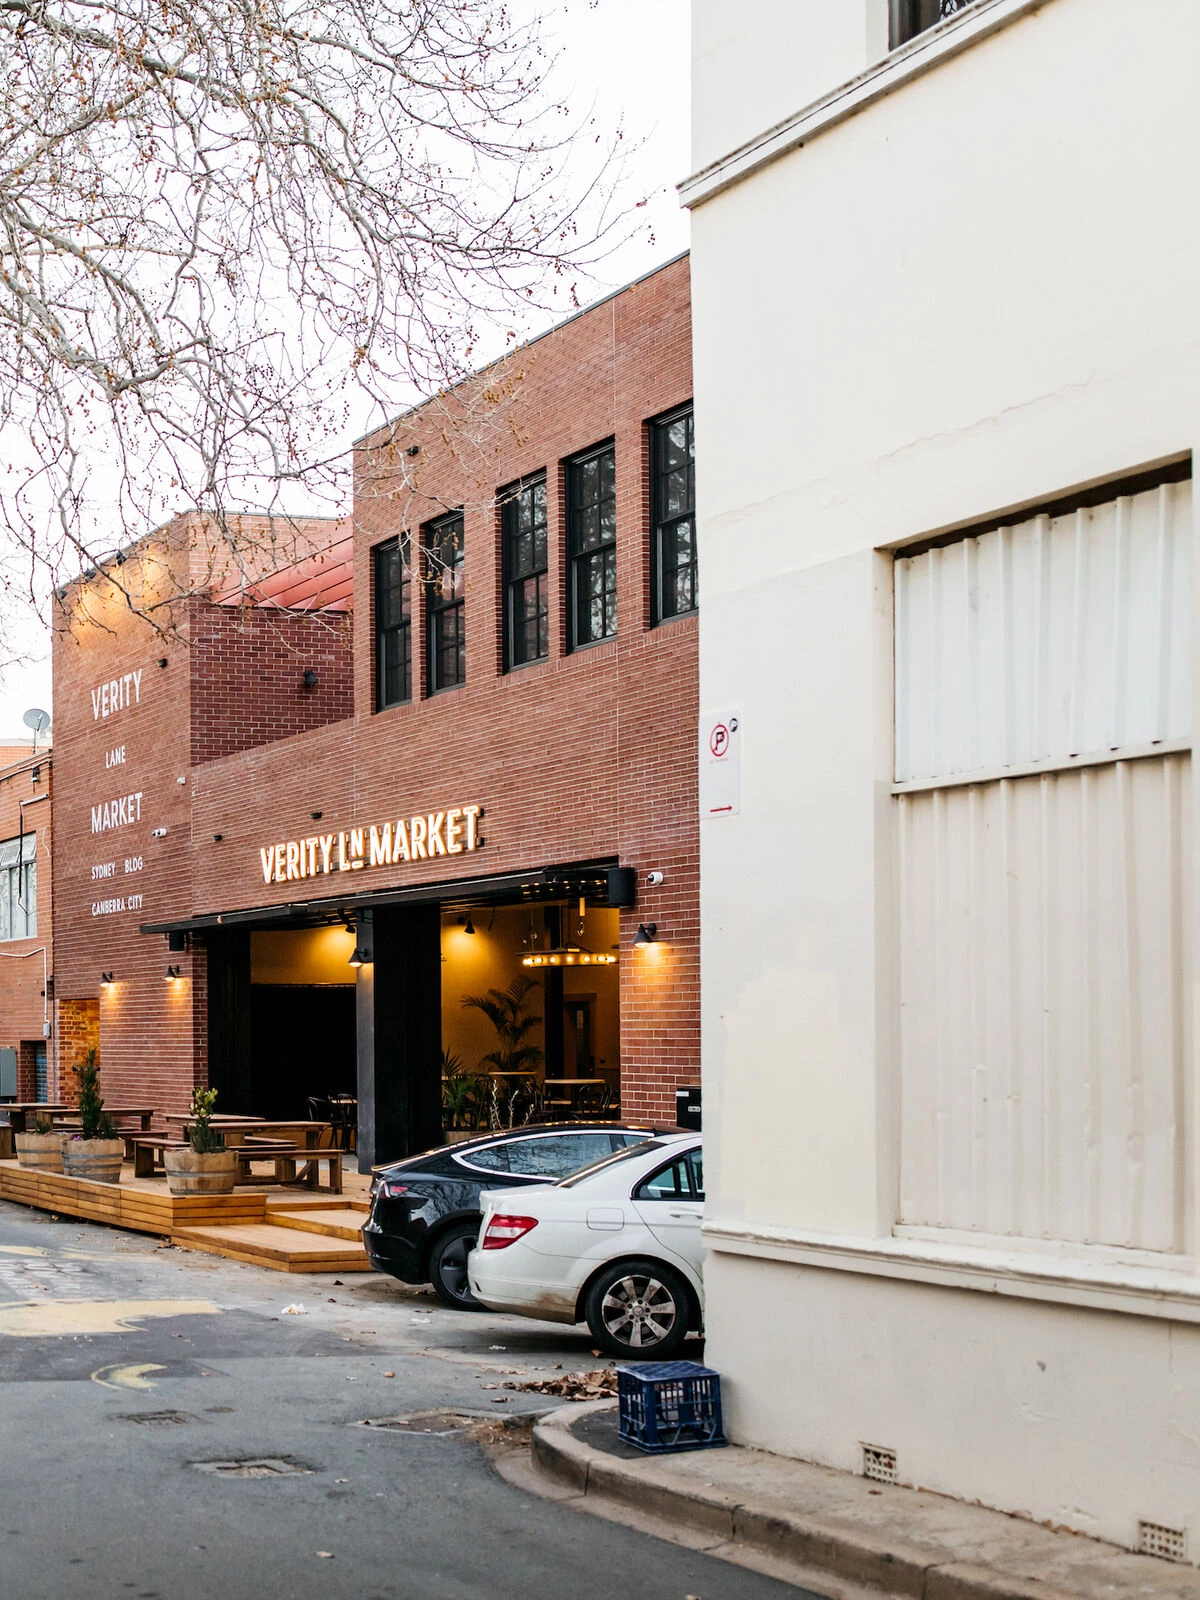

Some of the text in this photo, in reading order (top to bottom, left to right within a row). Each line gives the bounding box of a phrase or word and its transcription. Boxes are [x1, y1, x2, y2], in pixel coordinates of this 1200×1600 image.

[91, 668, 143, 721] VERITY
[105, 745, 126, 769] LANE
[91, 791, 143, 834] MARKET
[260, 833, 334, 884] VERITY
[369, 805, 481, 866] MARKET
[91, 856, 143, 881] SYDNEY BLDG
[91, 894, 143, 917] CANBERRA CITY
